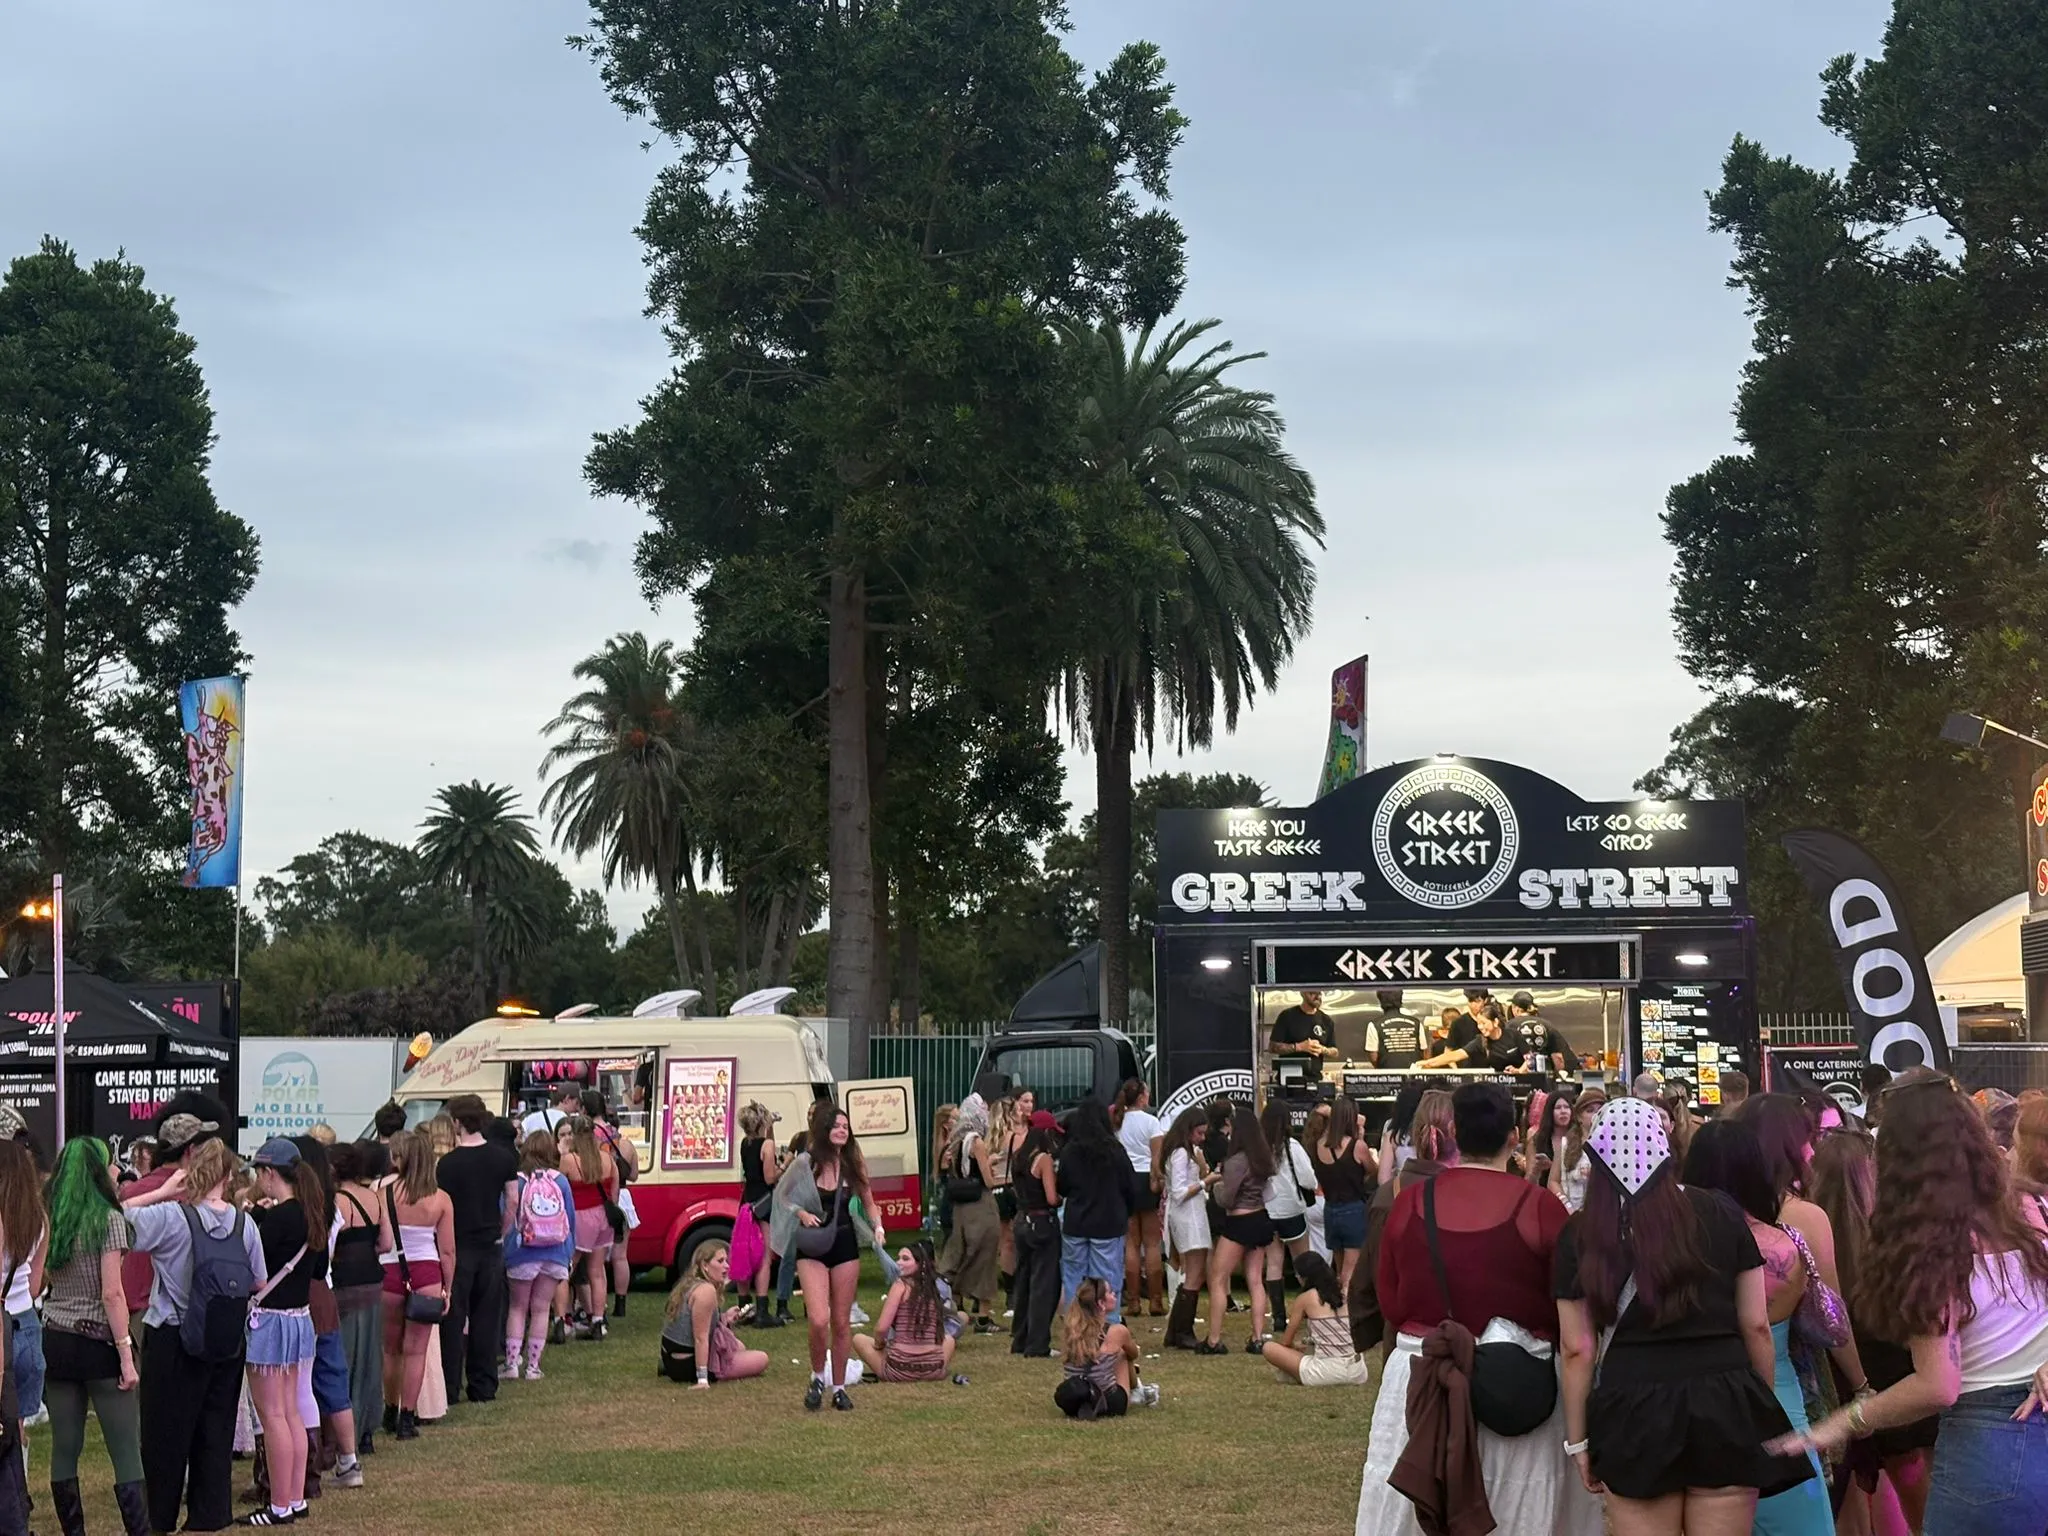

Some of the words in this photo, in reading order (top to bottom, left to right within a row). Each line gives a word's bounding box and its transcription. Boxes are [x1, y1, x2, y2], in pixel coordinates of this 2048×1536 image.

[1400, 783, 1445, 809] AUTHENTIC
[1449, 783, 1489, 809] CHARCOAL
[1228, 820, 1267, 837] HERE
[1270, 820, 1306, 837] YOU
[1405, 810, 1485, 836] GREEK
[1566, 815, 1600, 832] LETS
[1603, 814, 1632, 832] GO
[1634, 813, 1688, 831] GREEK
[1214, 839, 1262, 857] TASTE
[1265, 839, 1322, 856] GREECE
[1600, 834, 1654, 851] GYROS
[1400, 840, 1492, 866] STREET
[1171, 871, 1367, 913] GREEK
[1423, 879, 1471, 891] ROTISSERIE
[1518, 866, 1739, 910] STREET
[1335, 948, 1433, 981] GREEK
[1444, 947, 1557, 980] STREET
[1829, 878, 1937, 1081] OOD
[1676, 987, 1702, 997] Menu
[29, 1046, 57, 1056] TEQUIL
[115, 1043, 147, 1055] TEQUILA
[1784, 1061, 1791, 1069] A
[1793, 1061, 1814, 1069] ONE
[1817, 1060, 1864, 1069] CATERING
[95, 1070, 125, 1087] CAME
[128, 1069, 152, 1086] FOR
[155, 1069, 177, 1085] THE
[180, 1068, 219, 1084] MUSIC.
[1812, 1071, 1834, 1080] NSW
[1837, 1071, 1855, 1079] PTY
[0, 1084, 29, 1094] APEFRUIT
[31, 1083, 56, 1093] PALOMA
[108, 1087, 149, 1104] STAYED
[153, 1086, 177, 1103] FOR
[1227, 1091, 1253, 1103] CHAR
[22, 1097, 41, 1107] SODA
[254, 1103, 324, 1113] MOBILE
[1290, 1111, 1308, 1119] DER
[887, 1203, 912, 1217] 975
